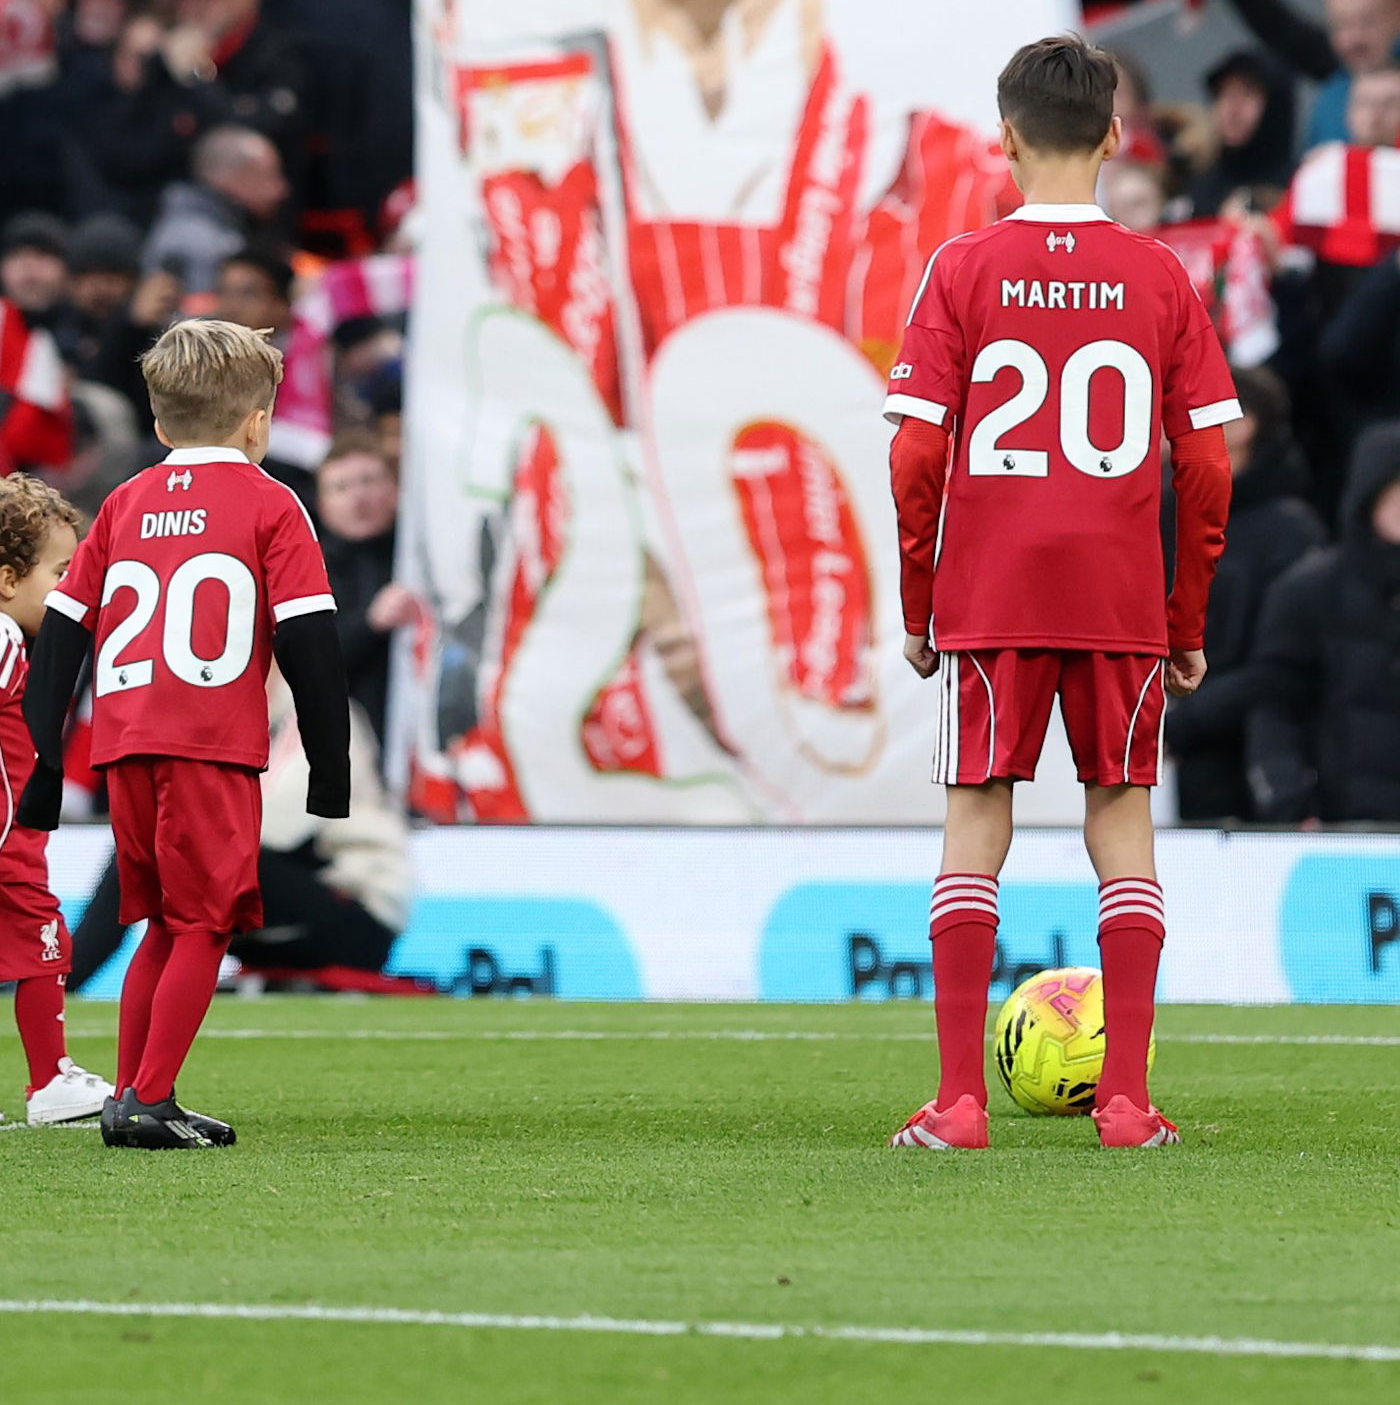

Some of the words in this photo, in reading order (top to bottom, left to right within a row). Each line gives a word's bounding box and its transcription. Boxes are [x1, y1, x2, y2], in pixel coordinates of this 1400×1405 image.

[1001, 279, 1125, 311] MARTIM
[968, 338, 1153, 478] 20
[140, 509, 207, 540] DINIS
[96, 552, 257, 698] 20
